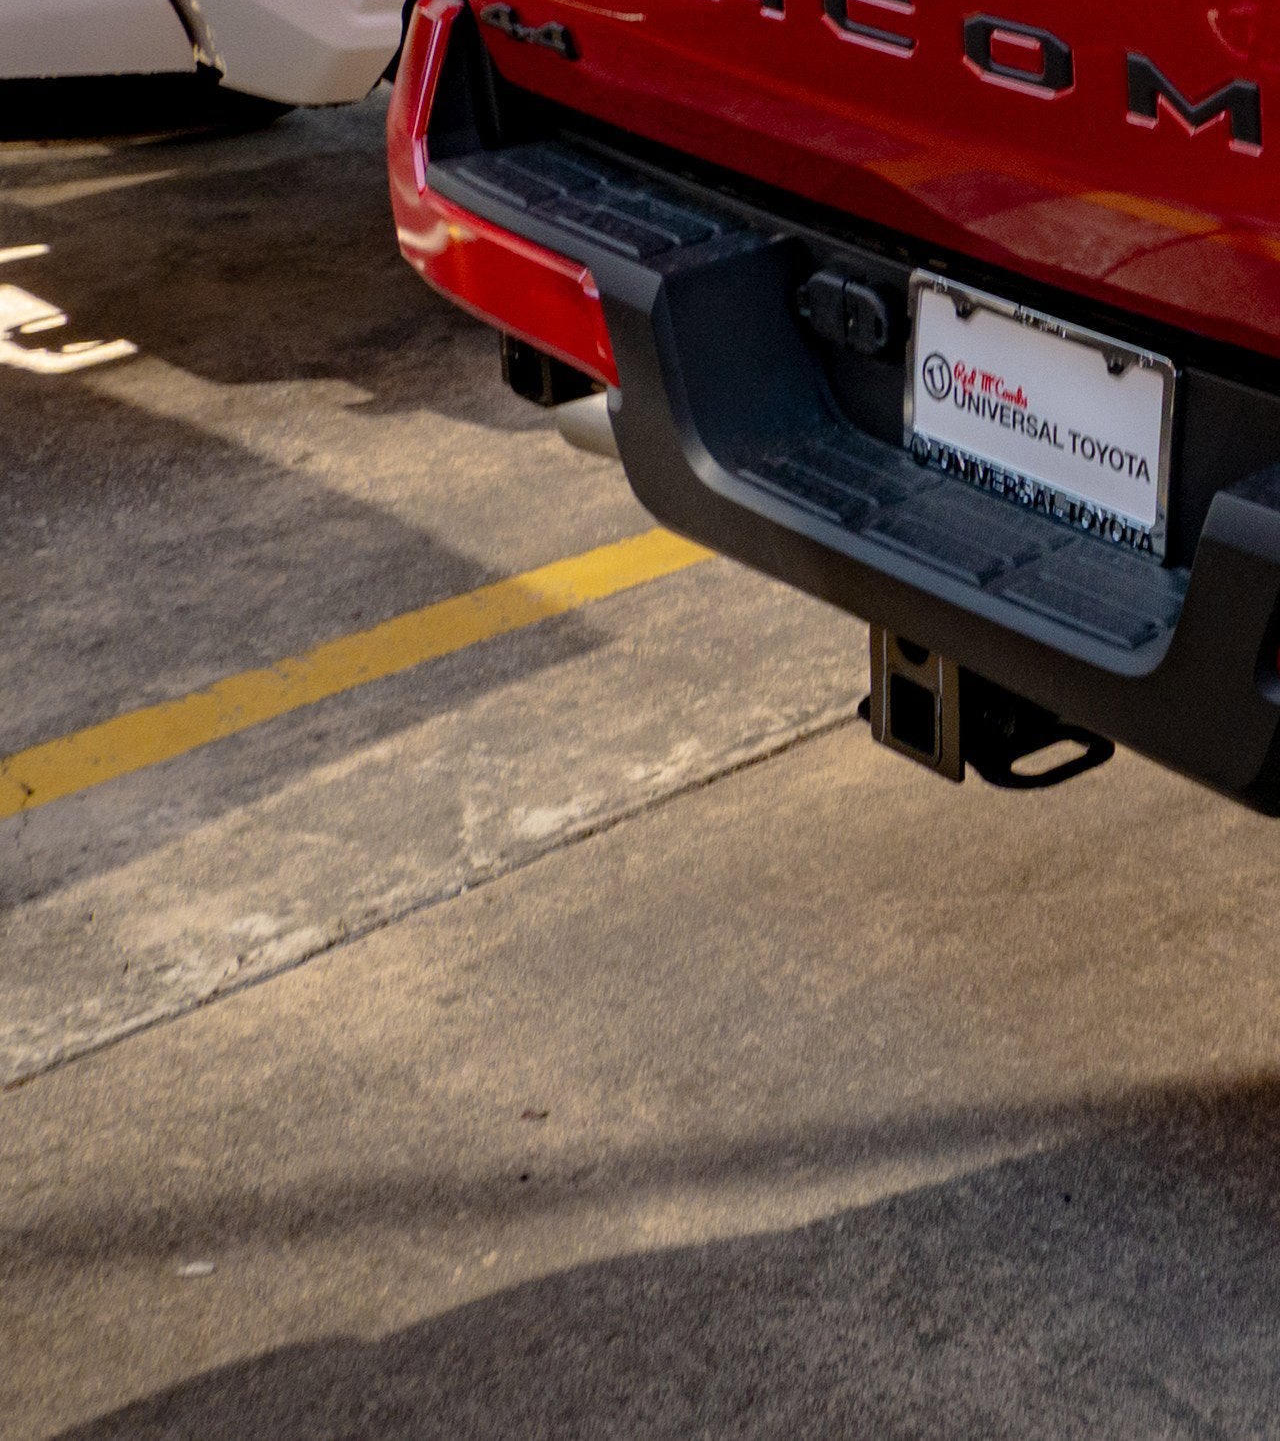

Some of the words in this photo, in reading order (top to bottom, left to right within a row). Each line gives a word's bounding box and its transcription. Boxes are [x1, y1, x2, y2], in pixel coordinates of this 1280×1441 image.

[953, 386, 1064, 450] UNIVERSAL
[1068, 428, 1151, 483] TOYOTA
[938, 441, 1064, 518] UNIVERSAL
[1067, 496, 1153, 552] TOYOTA
